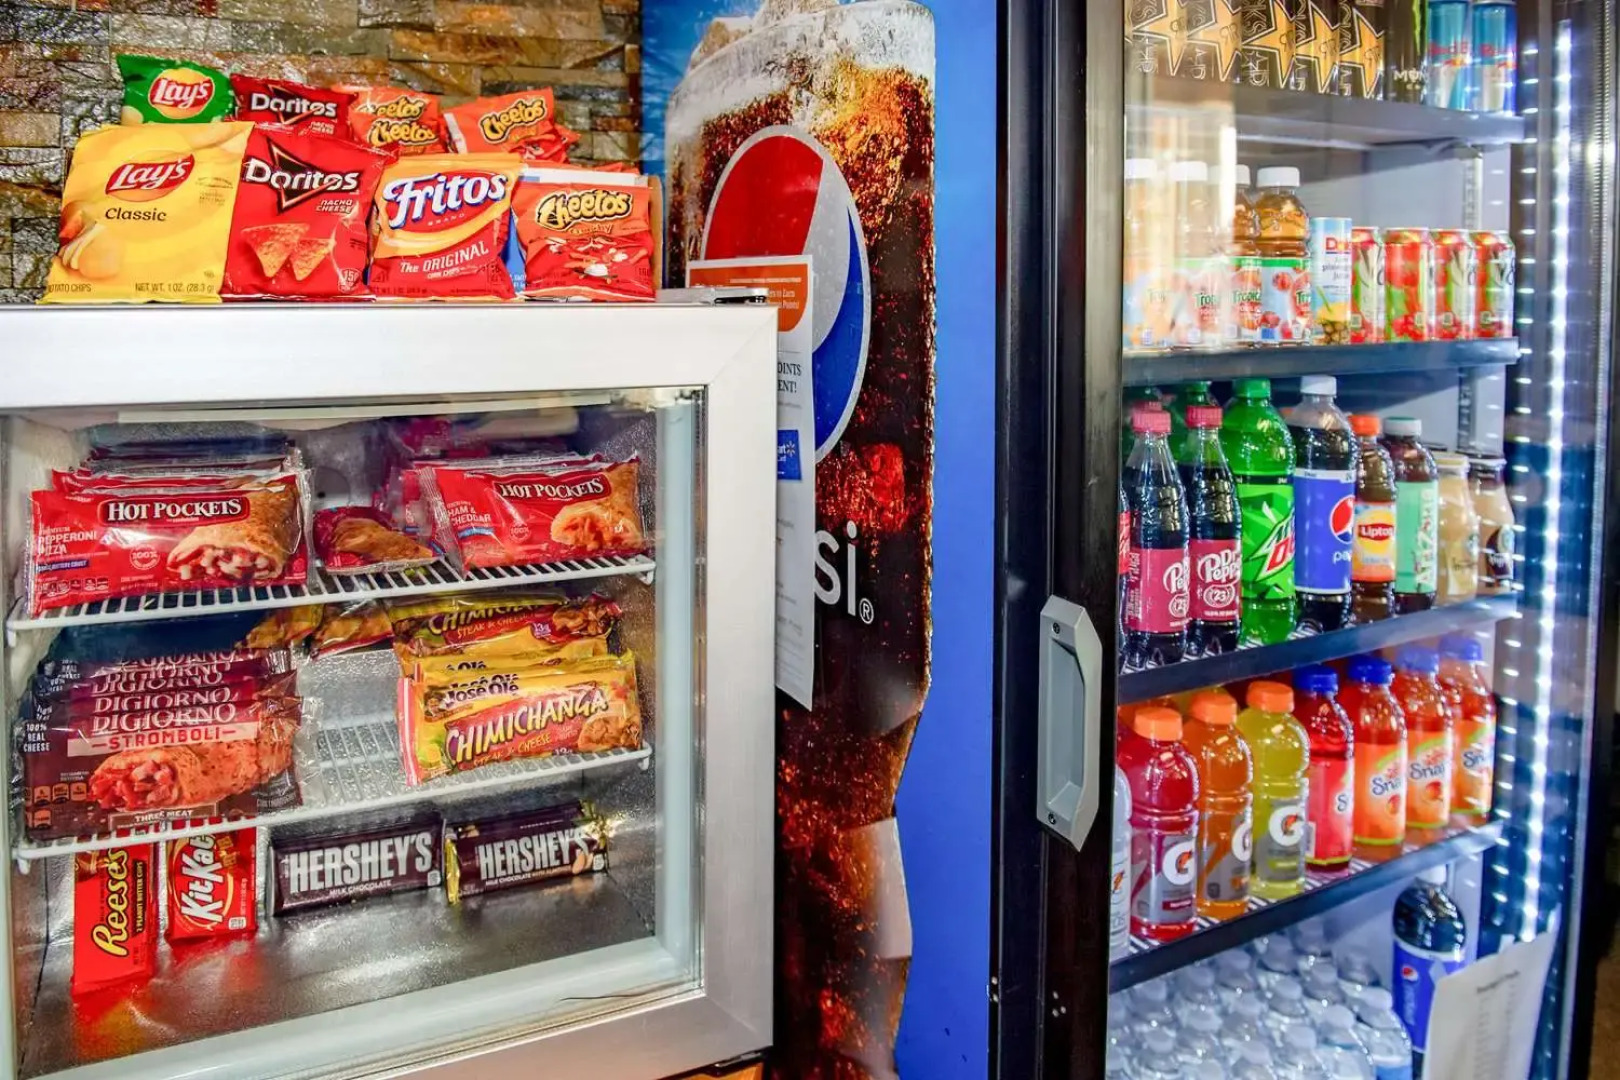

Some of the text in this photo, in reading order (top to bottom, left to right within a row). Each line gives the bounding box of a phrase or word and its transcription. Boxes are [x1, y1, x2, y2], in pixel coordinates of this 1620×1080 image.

[152, 78, 211, 109] Lay's
[250, 92, 337, 117] Doritos
[369, 120, 436, 147] Cheetos
[481, 100, 545, 141] Cheetos
[110, 156, 192, 192] Lay's
[245, 157, 360, 191] Doritos
[104, 206, 167, 222] Classic
[382, 172, 508, 230] Fritos
[537, 190, 632, 229] Cheetos
[400, 241, 490, 273] The ORIGINAL
[49, 283, 92, 293] OTATO CHIPS
[778, 362, 801, 377] OINTS
[778, 380, 797, 394] ENT!
[500, 477, 605, 498] HOT POCKETS
[106, 498, 242, 522] HOT POCKETS
[94, 687, 231, 713] DIGIORNO
[92, 702, 237, 734] DIGIORNO
[445, 687, 610, 766] CHIMICHANGA
[23, 742, 51, 753] CHEESE
[109, 727, 221, 750] STROMBOLI
[289, 832, 433, 895] HERSHEY'S
[478, 826, 591, 881] HERSHEY'S
